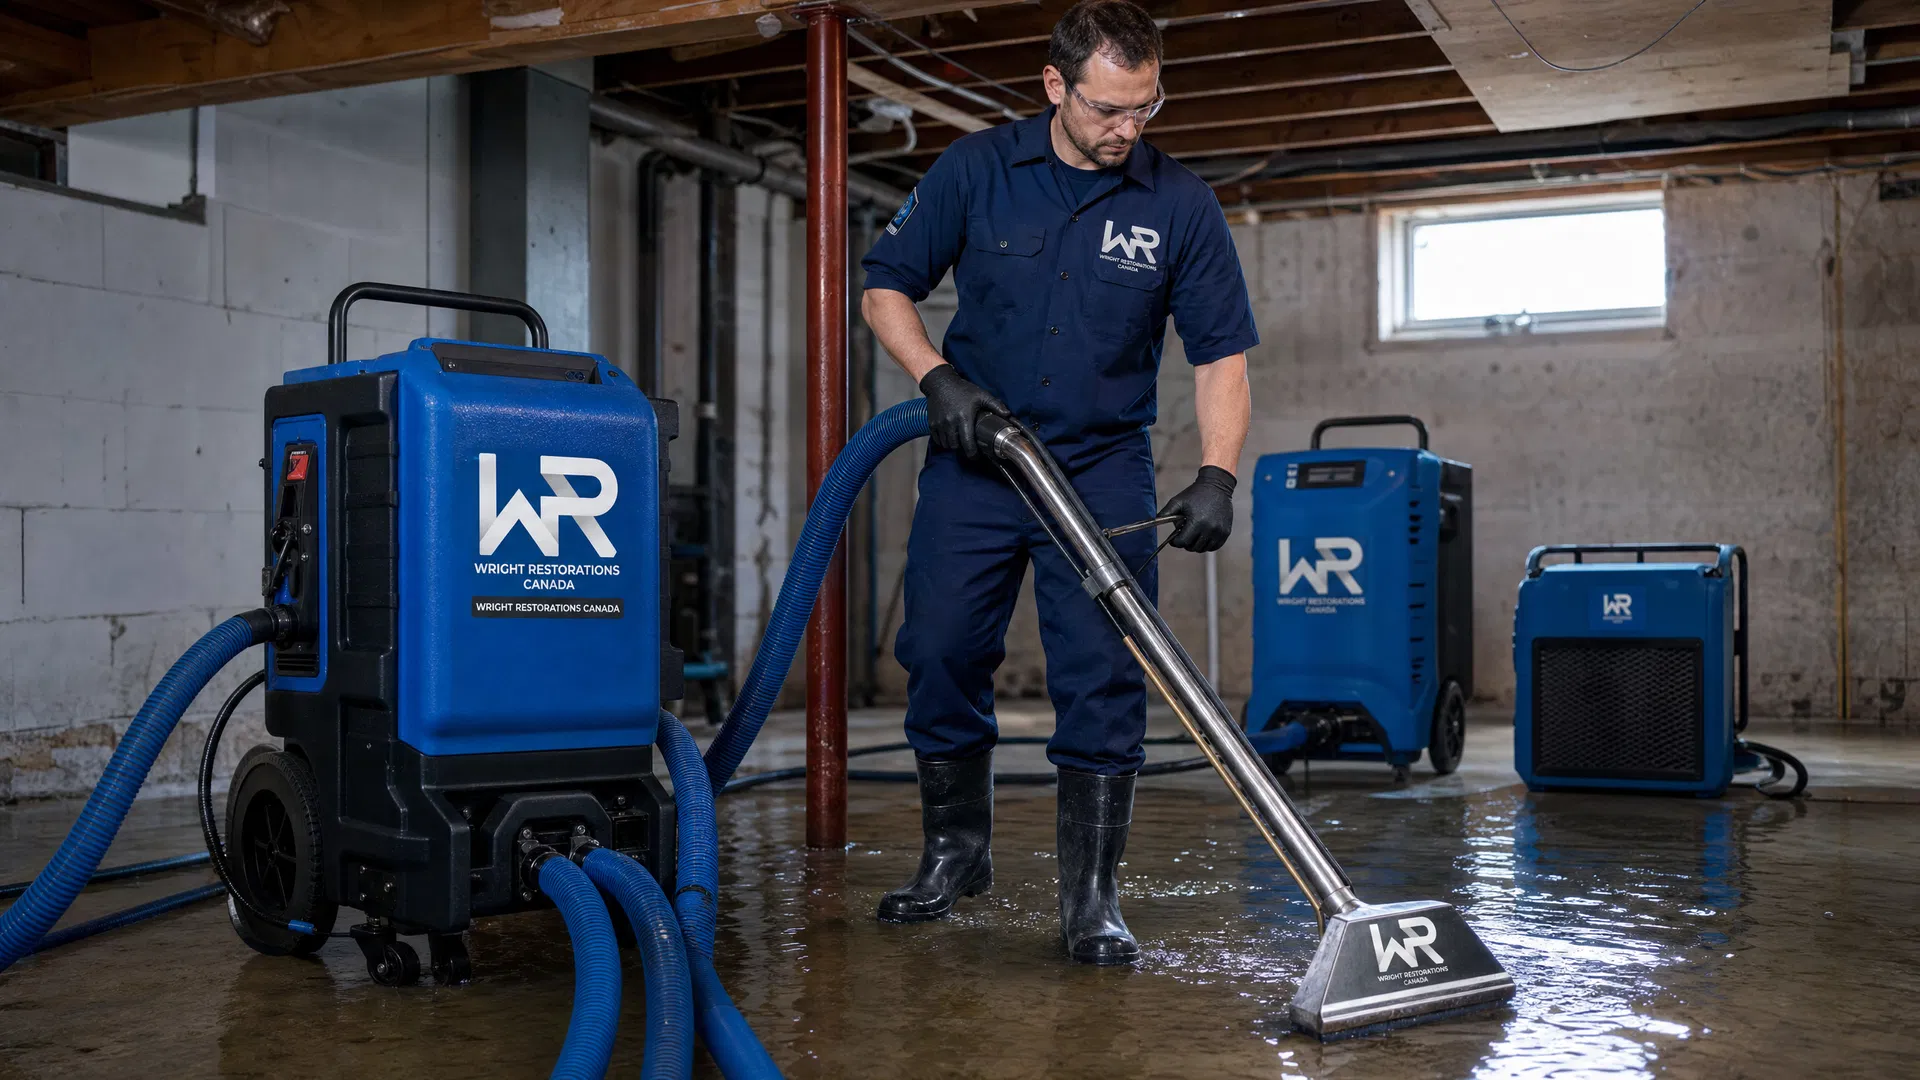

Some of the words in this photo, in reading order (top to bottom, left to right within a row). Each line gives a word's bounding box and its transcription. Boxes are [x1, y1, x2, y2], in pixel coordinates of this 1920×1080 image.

[1099, 253, 1120, 263] WRIGHT
[1117, 263, 1139, 273] CANADA
[474, 562, 526, 575] WRIGHT
[528, 563, 621, 576] RESTORATIONS
[523, 578, 575, 590] CANADA
[475, 602, 514, 612] WRIGHT
[515, 603, 582, 613] RESTORATIONS
[583, 604, 621, 613] CANADA
[1377, 972, 1403, 983] WRIGHT
[1403, 965, 1449, 978] RESTORATIONS
[1403, 976, 1429, 986] CANADA
